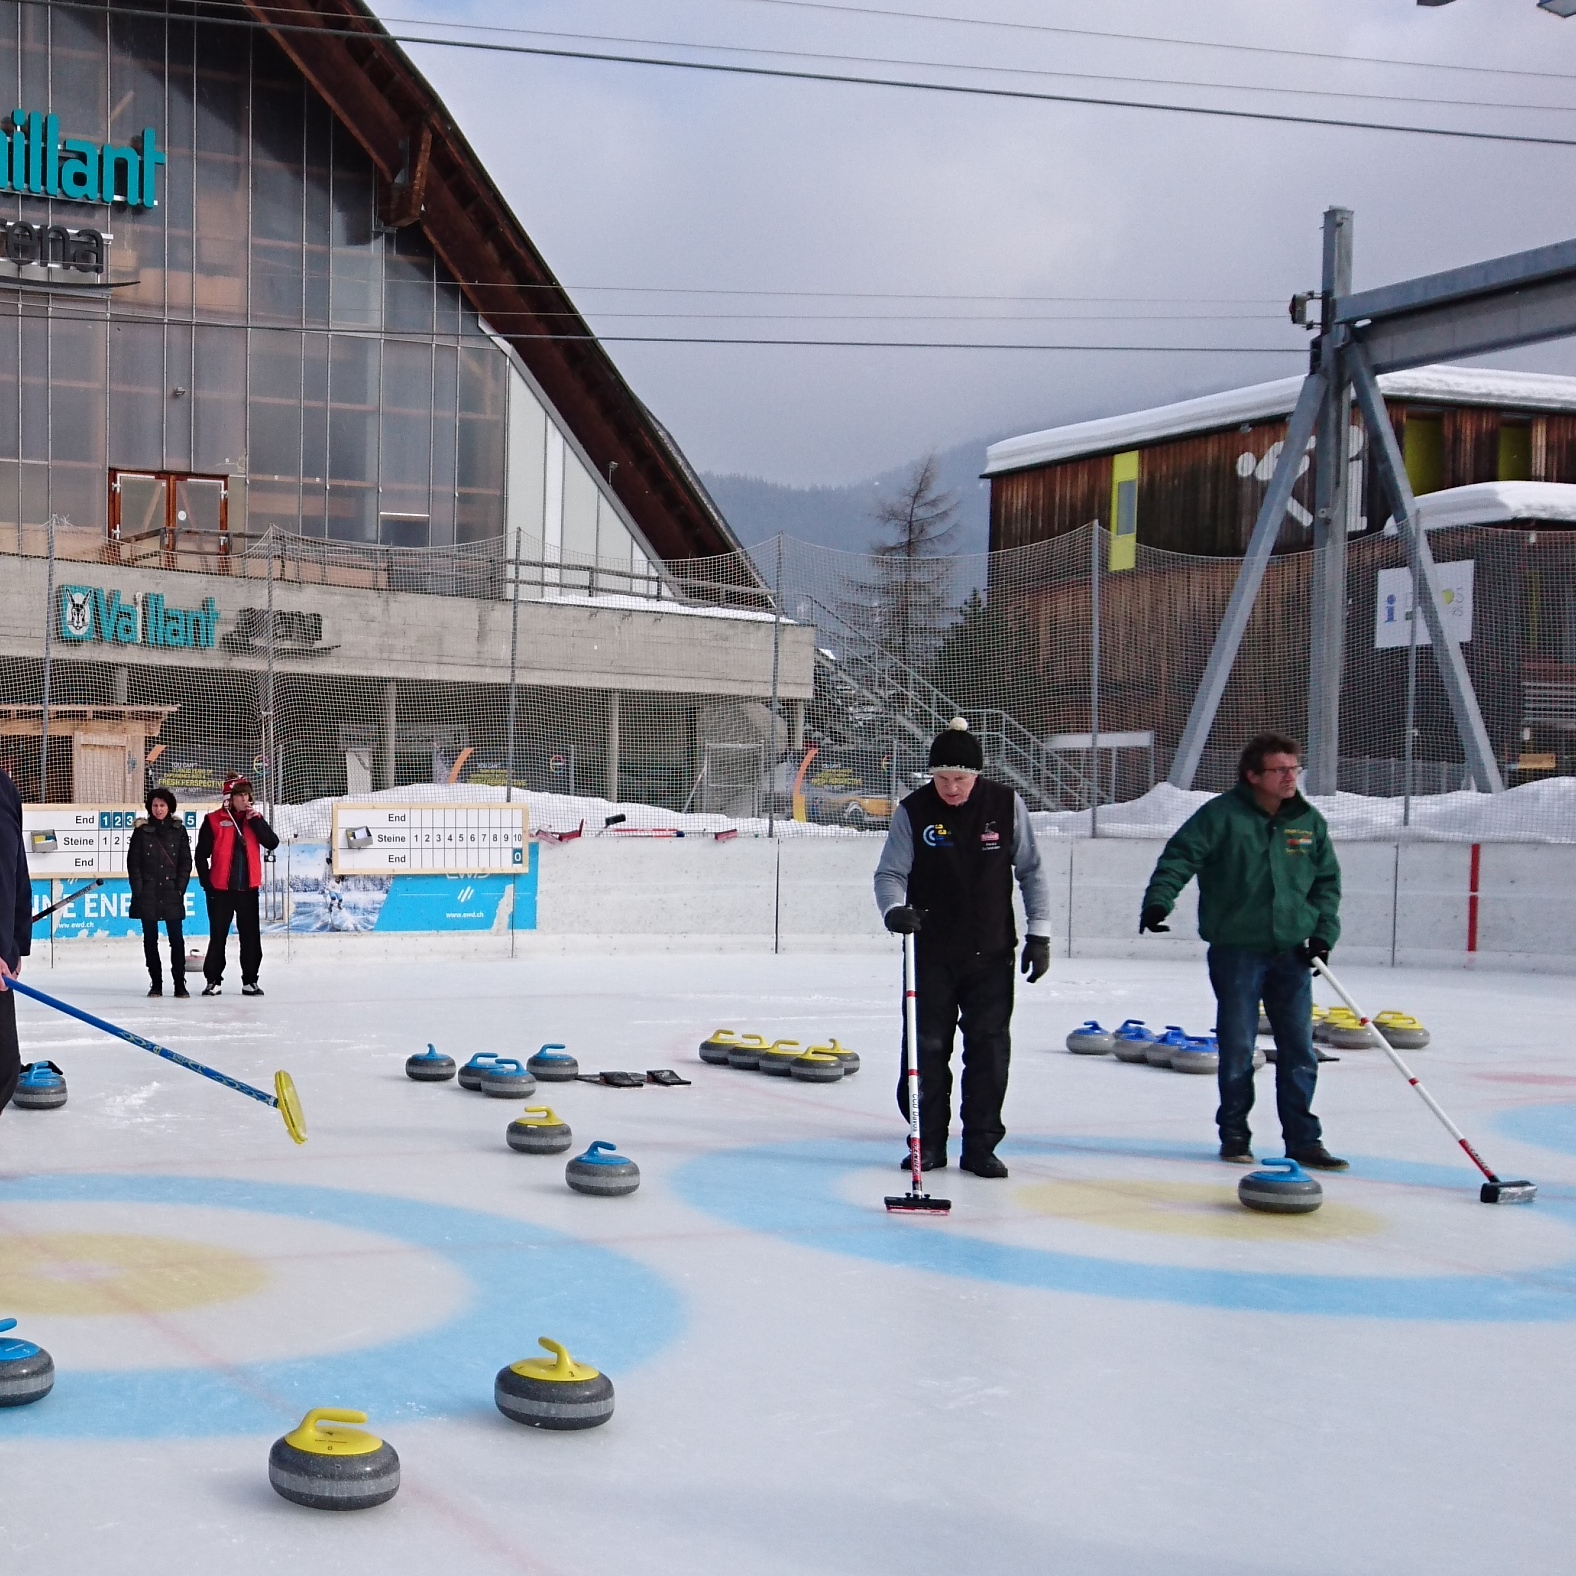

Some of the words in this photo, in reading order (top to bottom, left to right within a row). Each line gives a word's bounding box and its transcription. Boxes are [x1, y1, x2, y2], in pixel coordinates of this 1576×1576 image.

[92, 587, 221, 648] Vaillant
[75, 816, 95, 824] End
[103, 817, 108, 826] 1
[115, 817, 121, 826] 2
[187, 816, 194, 825] 5
[388, 814, 406, 822] End
[63, 837, 94, 846] Steine
[102, 837, 107, 846] 1
[114, 837, 120, 846] 2
[377, 834, 406, 842] Steine
[414, 834, 418, 842] 1
[424, 834, 430, 842] 2
[436, 834, 442, 842] 3
[447, 834, 453, 842] 4
[458, 834, 464, 842] 5
[470, 834, 475, 842] 6
[481, 834, 487, 842] 7
[492, 834, 498, 842] 8
[503, 834, 509, 842] 9
[513, 834, 522, 842] 10
[74, 858, 94, 866] End
[388, 855, 406, 863] End
